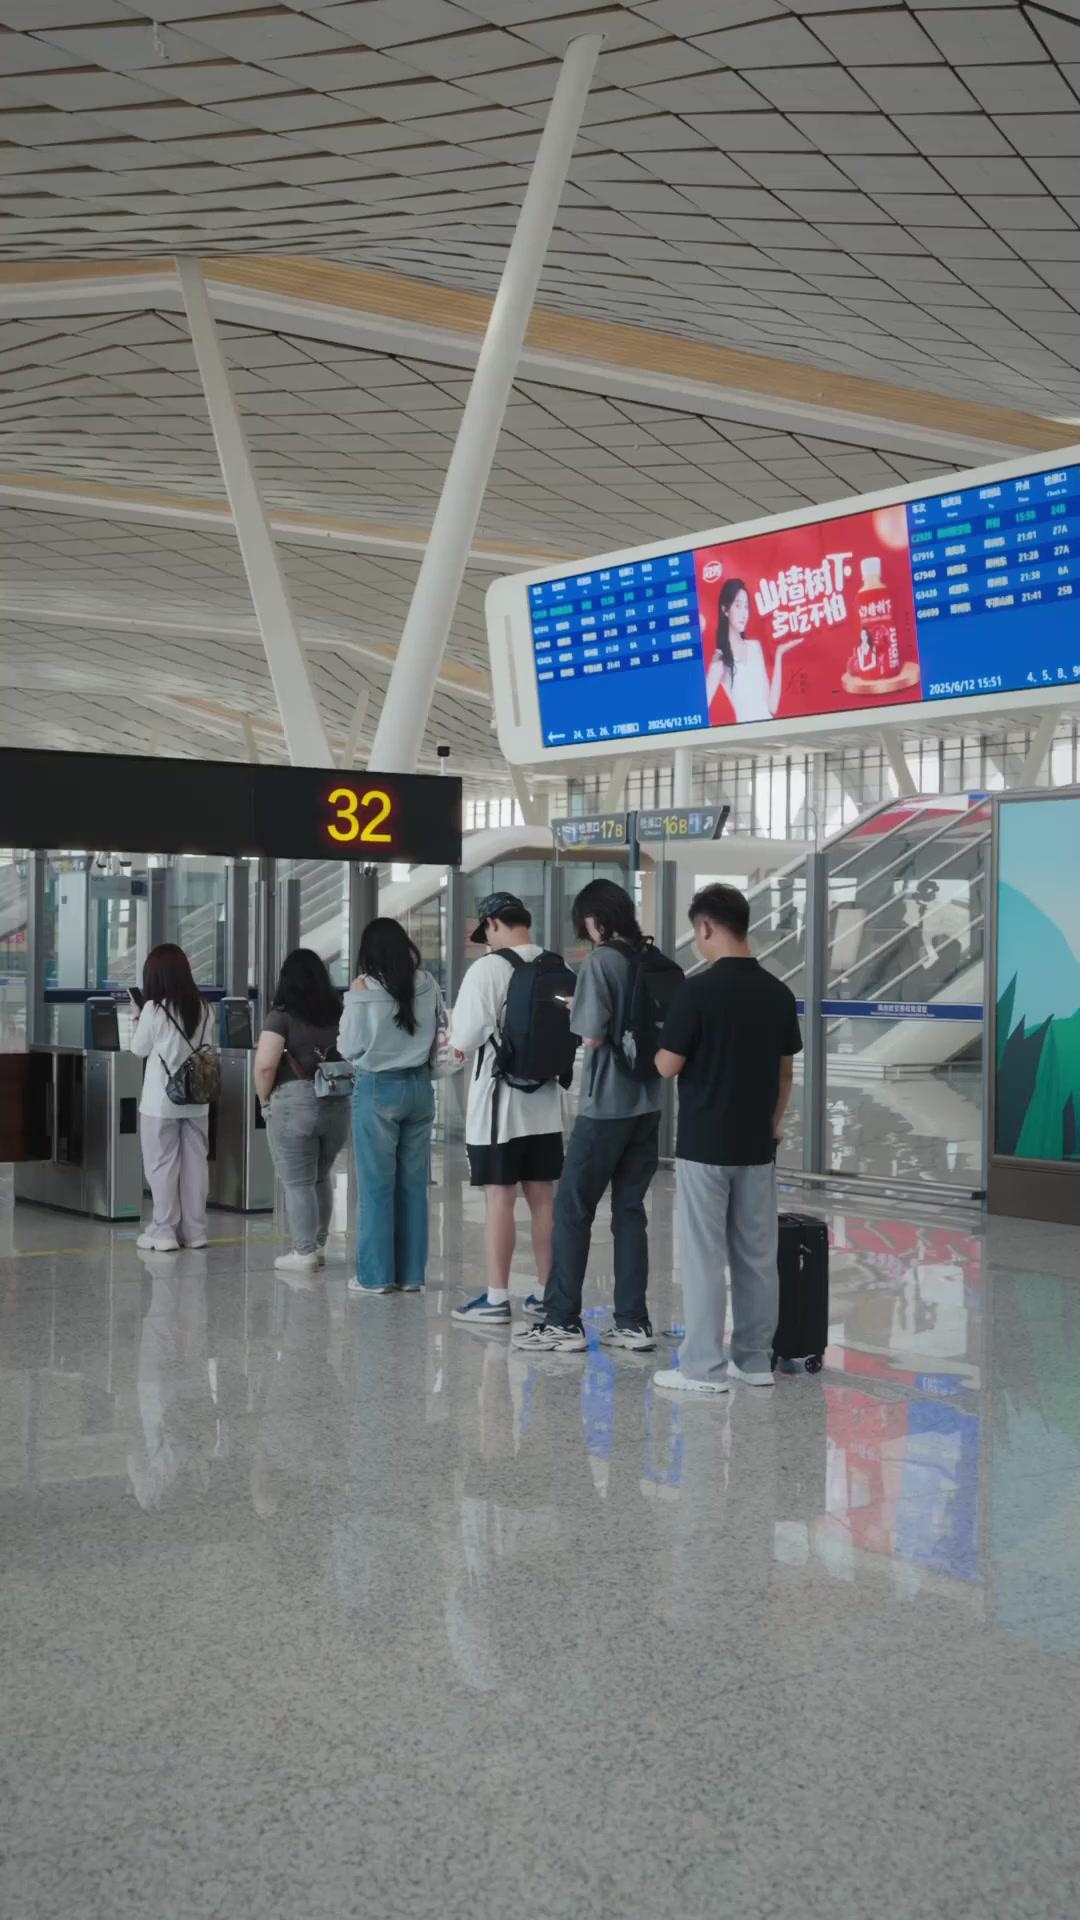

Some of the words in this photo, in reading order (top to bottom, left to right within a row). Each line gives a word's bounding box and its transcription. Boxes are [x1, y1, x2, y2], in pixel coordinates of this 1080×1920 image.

[755, 552, 853, 616] 山楂树下
[772, 592, 847, 639] 多吃不怕
[929, 679, 975, 695] 2025/6/12
[978, 675, 1002, 689] 15:51
[684, 714, 702, 726] 15:51
[327, 788, 392, 842] 32
